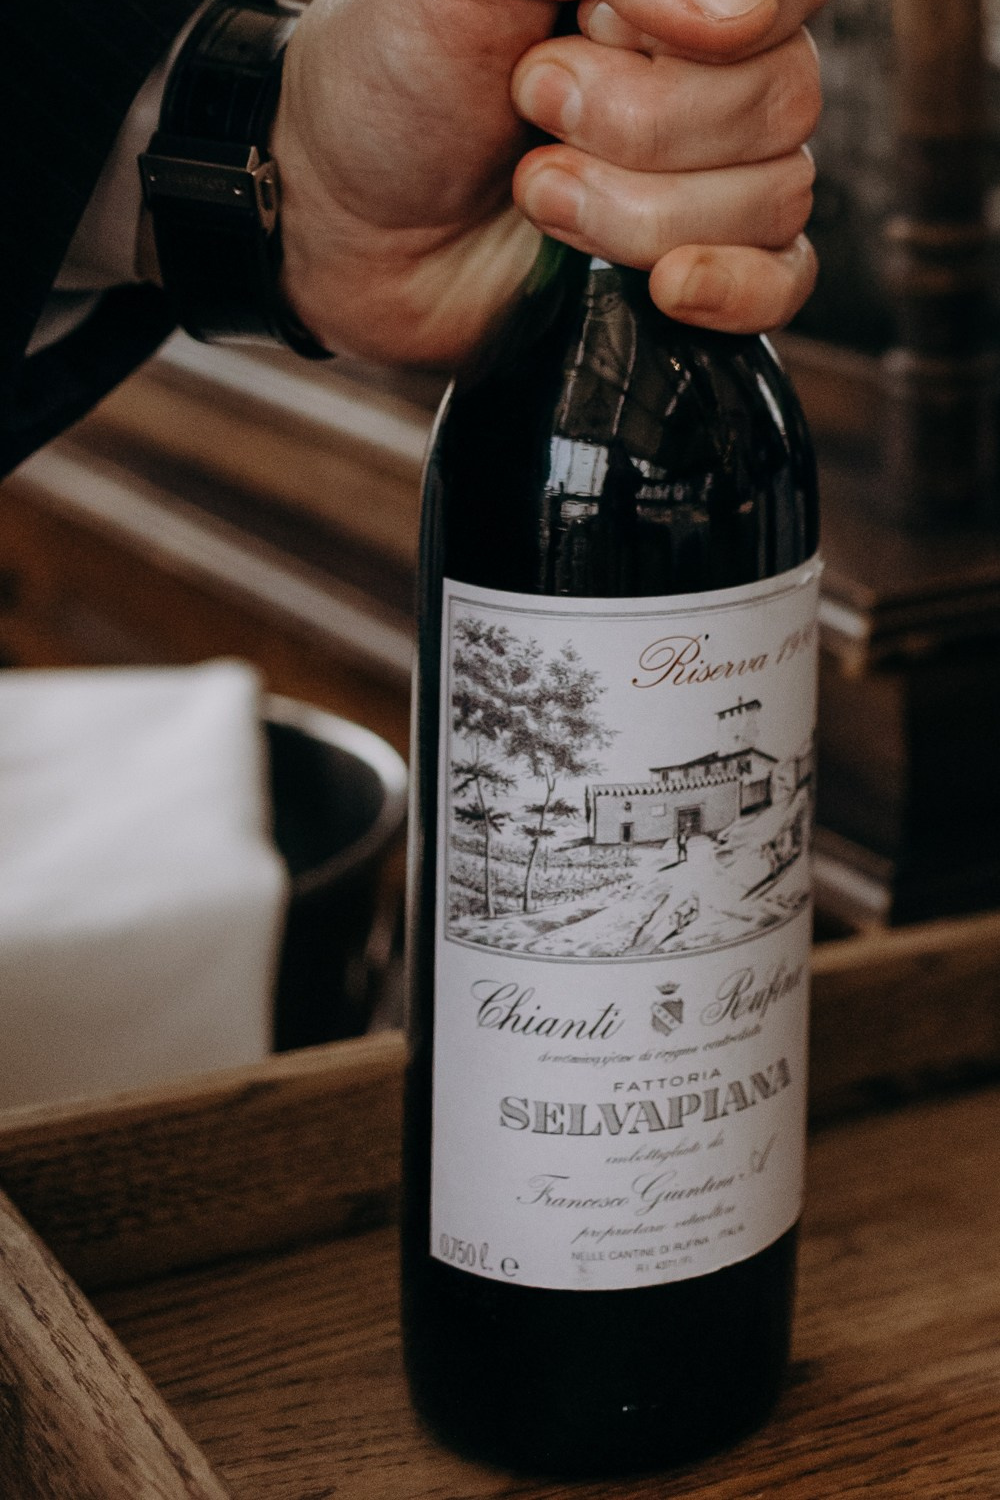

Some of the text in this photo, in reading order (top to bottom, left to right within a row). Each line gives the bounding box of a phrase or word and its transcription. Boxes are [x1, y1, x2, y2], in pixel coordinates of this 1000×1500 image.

[632, 634, 769, 689] Riserva
[471, 979, 625, 1041] Chianti
[500, 1057, 793, 1137] SELVAPIANA
[614, 1068, 722, 1093] FATTORIA
[516, 1173, 630, 1209] Francesco
[571, 1251, 605, 1262] NELLE
[608, 1247, 655, 1261] CANTINE
